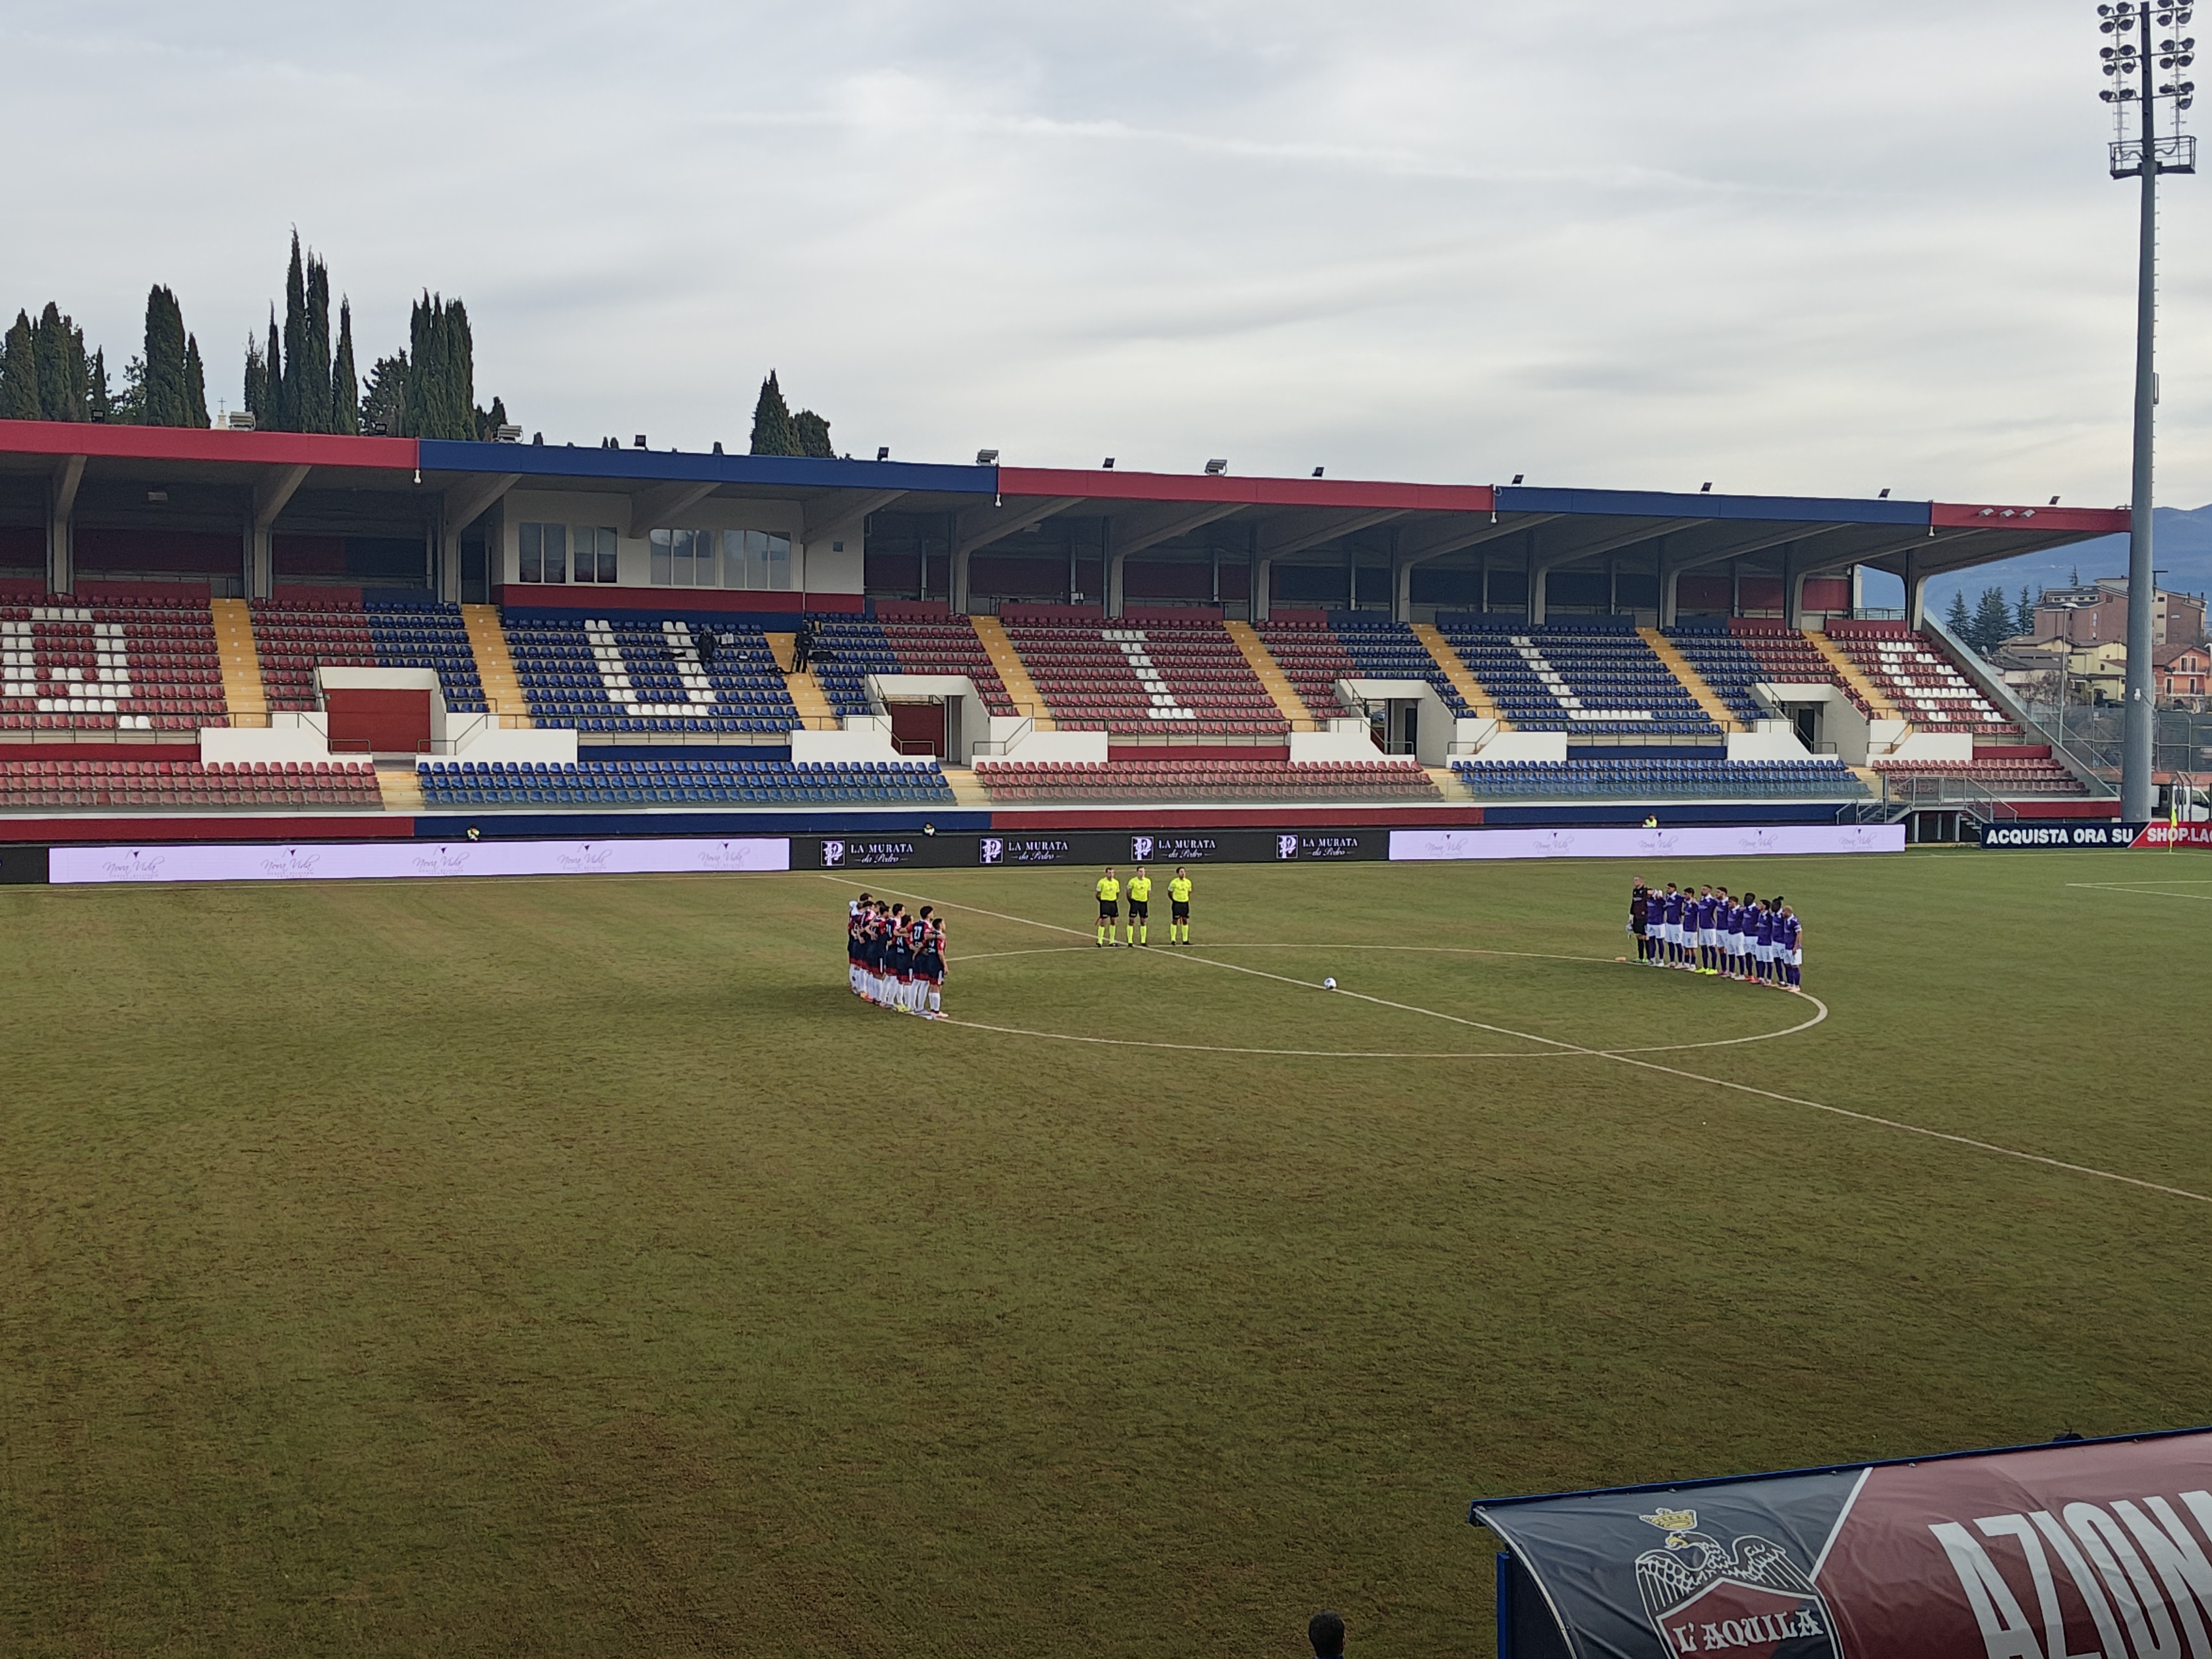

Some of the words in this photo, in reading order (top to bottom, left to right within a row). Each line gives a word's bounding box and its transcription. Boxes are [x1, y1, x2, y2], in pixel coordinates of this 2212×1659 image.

[584, 619, 718, 716] U
[1102, 630, 1195, 719] I
[1510, 636, 1651, 720] L
[1877, 642, 2006, 721] A
[1986, 828, 2068, 844] ACQUISTA
[2074, 829, 2107, 843] ORA
[2112, 829, 2133, 842] SU
[1008, 842, 1022, 851] LA
[1026, 841, 1068, 851] MURATA
[1158, 840, 1171, 849] LA
[1175, 840, 1216, 849] MURATA
[1303, 838, 1315, 847] LA
[1319, 838, 1358, 847] MURATA
[851, 844, 864, 854] LA
[868, 844, 913, 853] MURATA
[914, 926, 922, 939] 27
[1673, 1609, 1824, 1653] L'AQUILA
